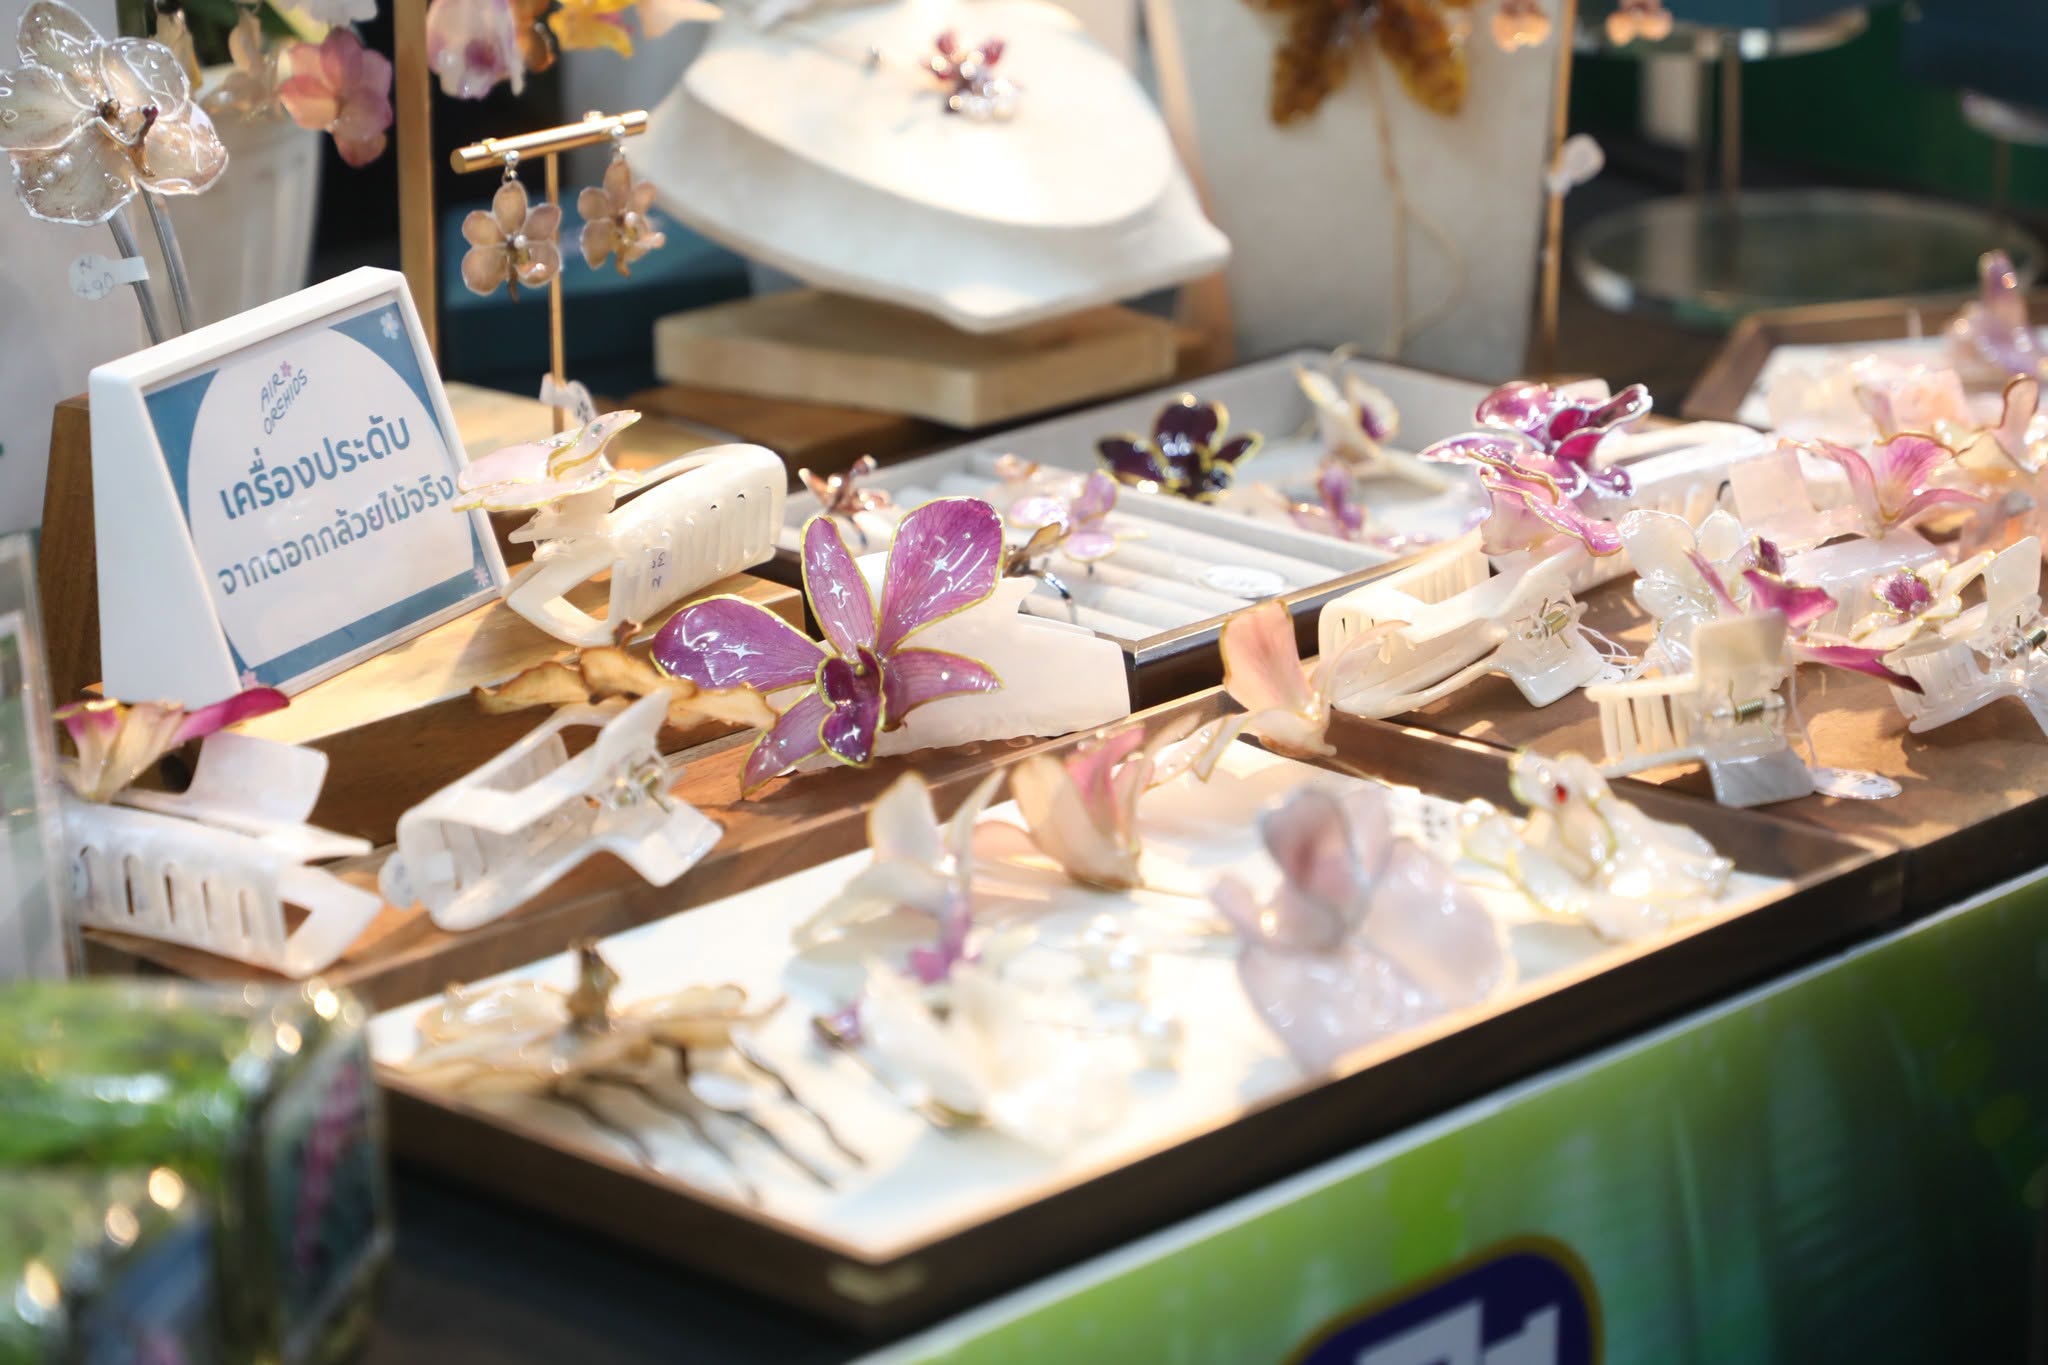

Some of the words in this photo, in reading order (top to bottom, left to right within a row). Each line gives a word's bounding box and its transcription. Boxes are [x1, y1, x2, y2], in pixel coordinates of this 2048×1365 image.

[260, 373, 285, 412] AIR
[263, 368, 308, 435] ORCHIDS
[220, 415, 410, 520] เครื่องประดับ
[218, 475, 454, 595] จากดอกกล้วยไม้จริง
